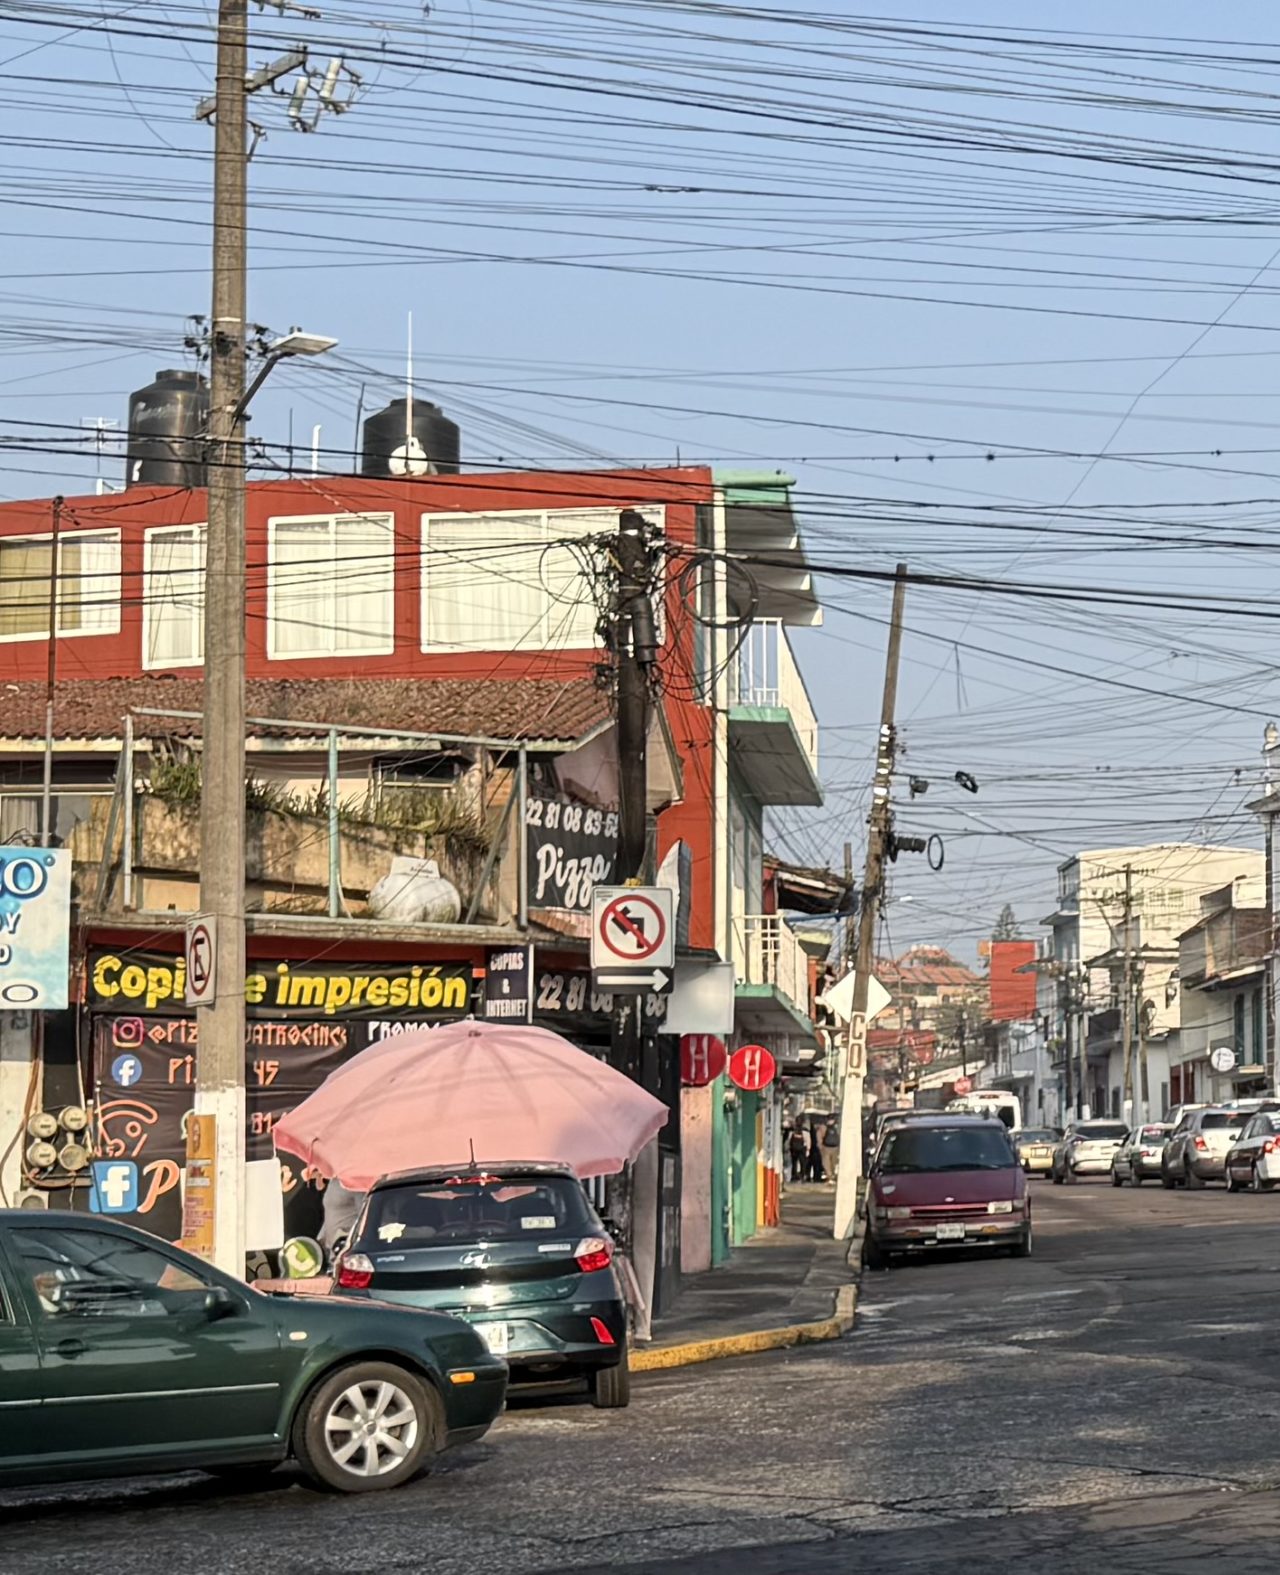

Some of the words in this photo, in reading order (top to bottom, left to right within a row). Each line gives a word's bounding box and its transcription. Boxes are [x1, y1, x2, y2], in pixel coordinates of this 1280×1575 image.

[545, 802, 561, 829] 81
[536, 843, 611, 908] Pizza
[93, 955, 187, 1008] Copi
[276, 963, 467, 1015] impresión
[486, 999, 527, 1017] INTERNET
